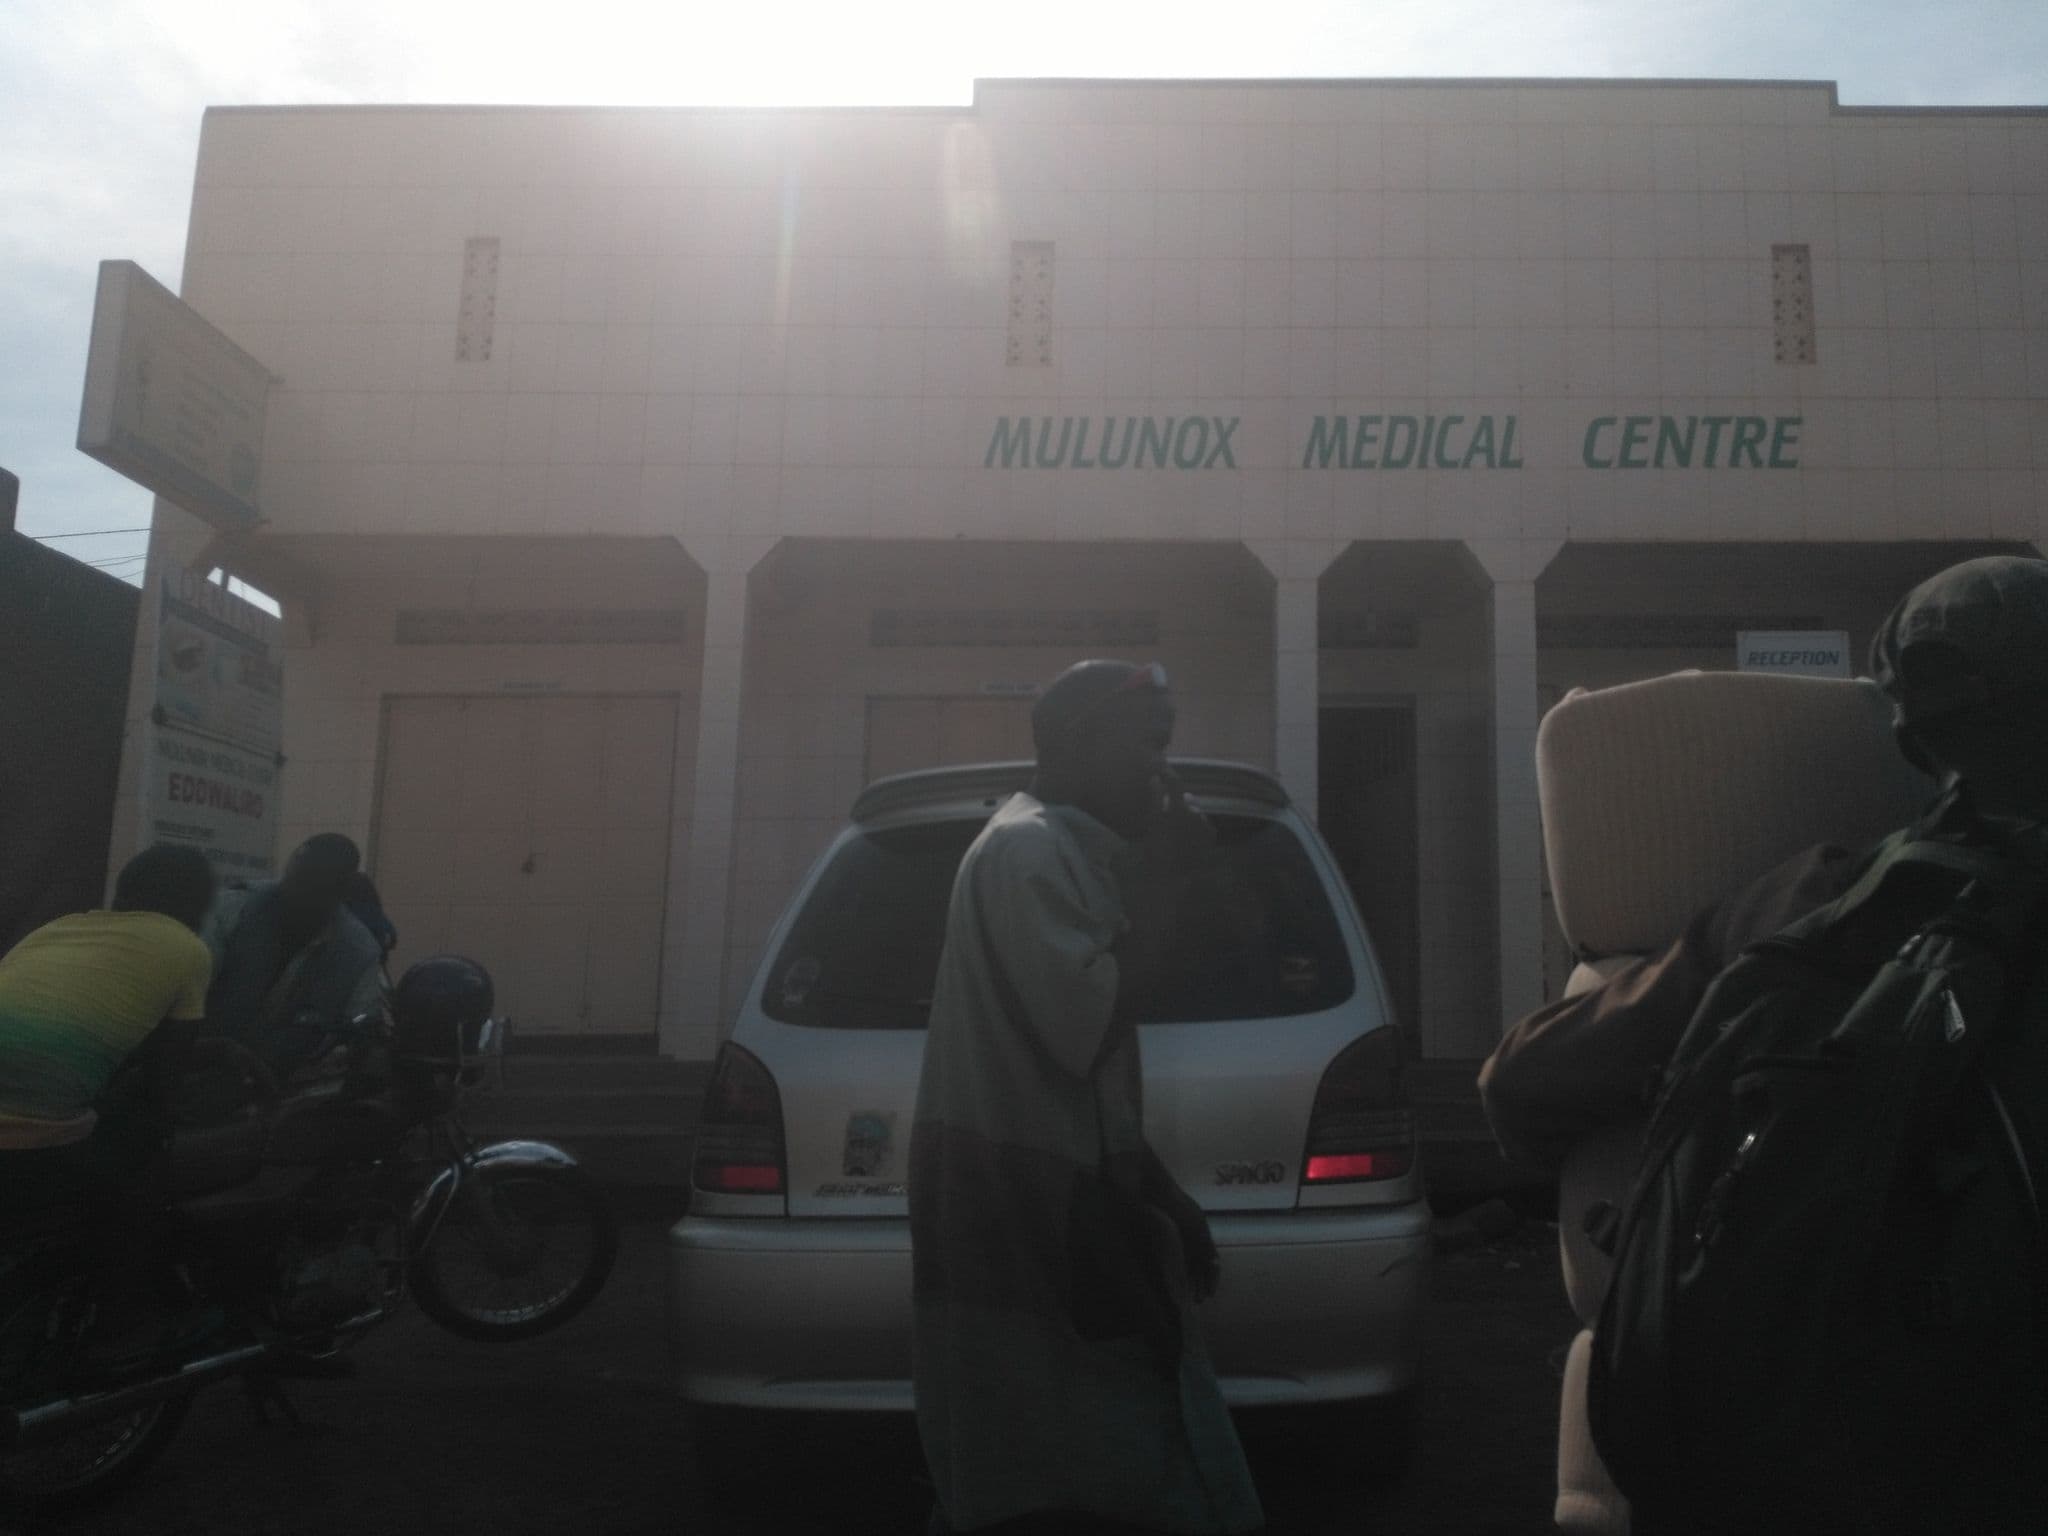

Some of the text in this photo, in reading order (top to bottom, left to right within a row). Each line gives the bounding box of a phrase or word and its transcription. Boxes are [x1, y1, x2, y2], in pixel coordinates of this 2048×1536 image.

[984, 415, 1803, 469] MULUNOX MEDICAL CENTRE
[1746, 650, 1840, 666] RECEPTION
